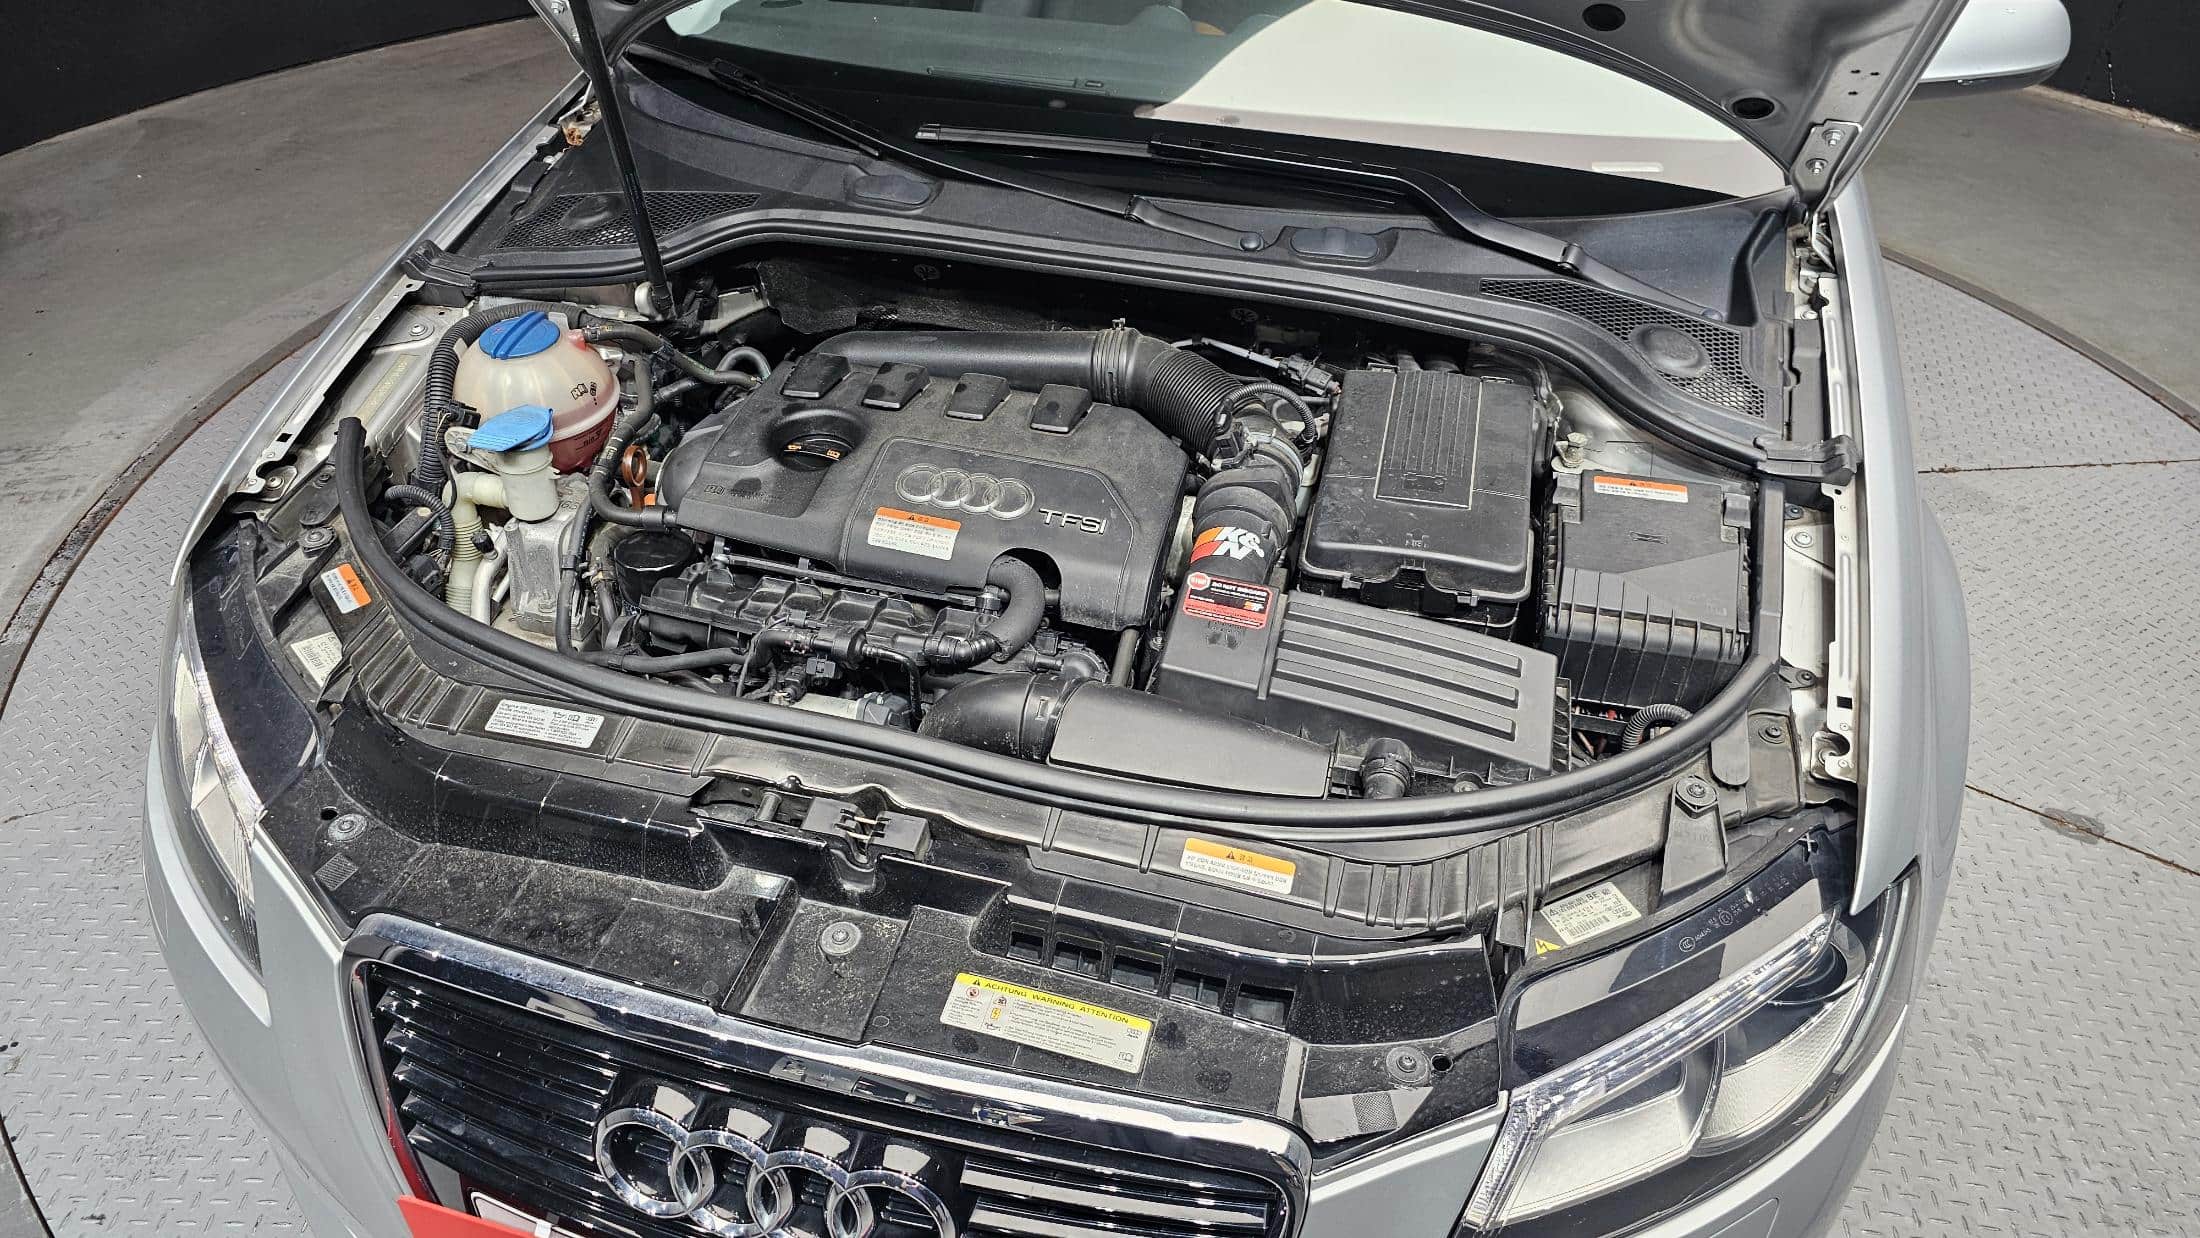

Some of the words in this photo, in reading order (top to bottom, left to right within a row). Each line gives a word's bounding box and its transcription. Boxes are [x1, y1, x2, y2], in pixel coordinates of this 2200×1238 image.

[1038, 508, 1108, 535] TFSI
[984, 982, 1027, 997] ACHTUNG
[1032, 993, 1075, 1010] WARNING
[1079, 1006, 1129, 1024] ATTENTION
